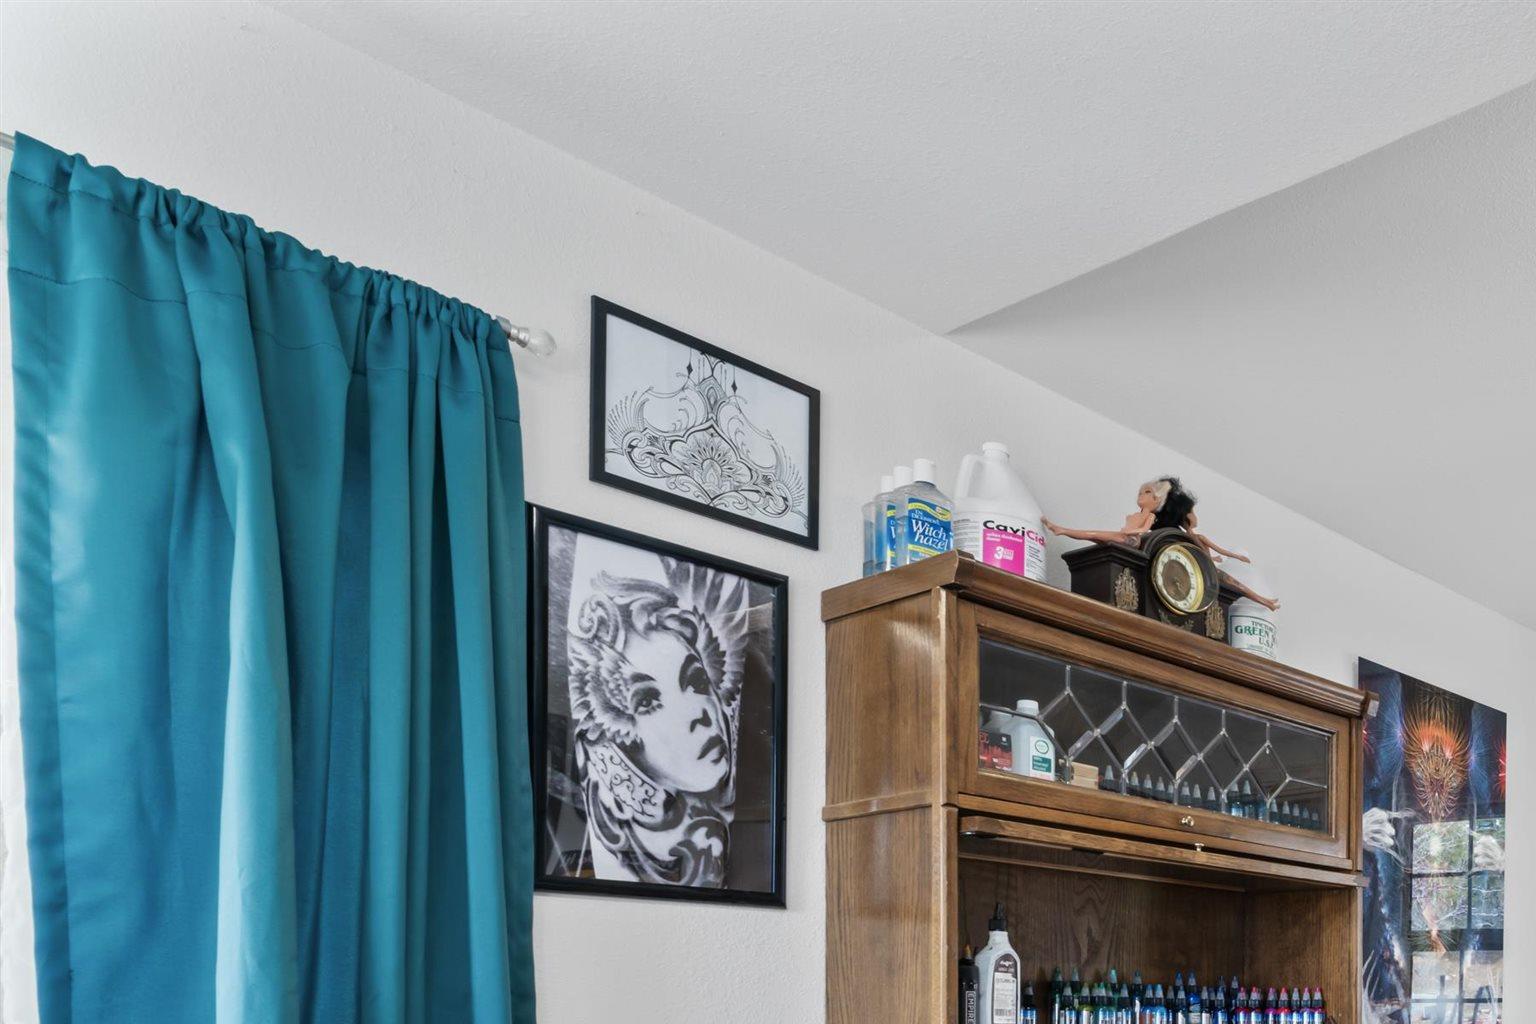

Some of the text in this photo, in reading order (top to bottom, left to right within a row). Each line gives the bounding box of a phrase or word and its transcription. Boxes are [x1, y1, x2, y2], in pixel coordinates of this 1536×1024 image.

[912, 519, 946, 541] Witch
[914, 530, 949, 550] hazel
[983, 520, 1046, 546] CaviCid
[994, 546, 1004, 560] 3
